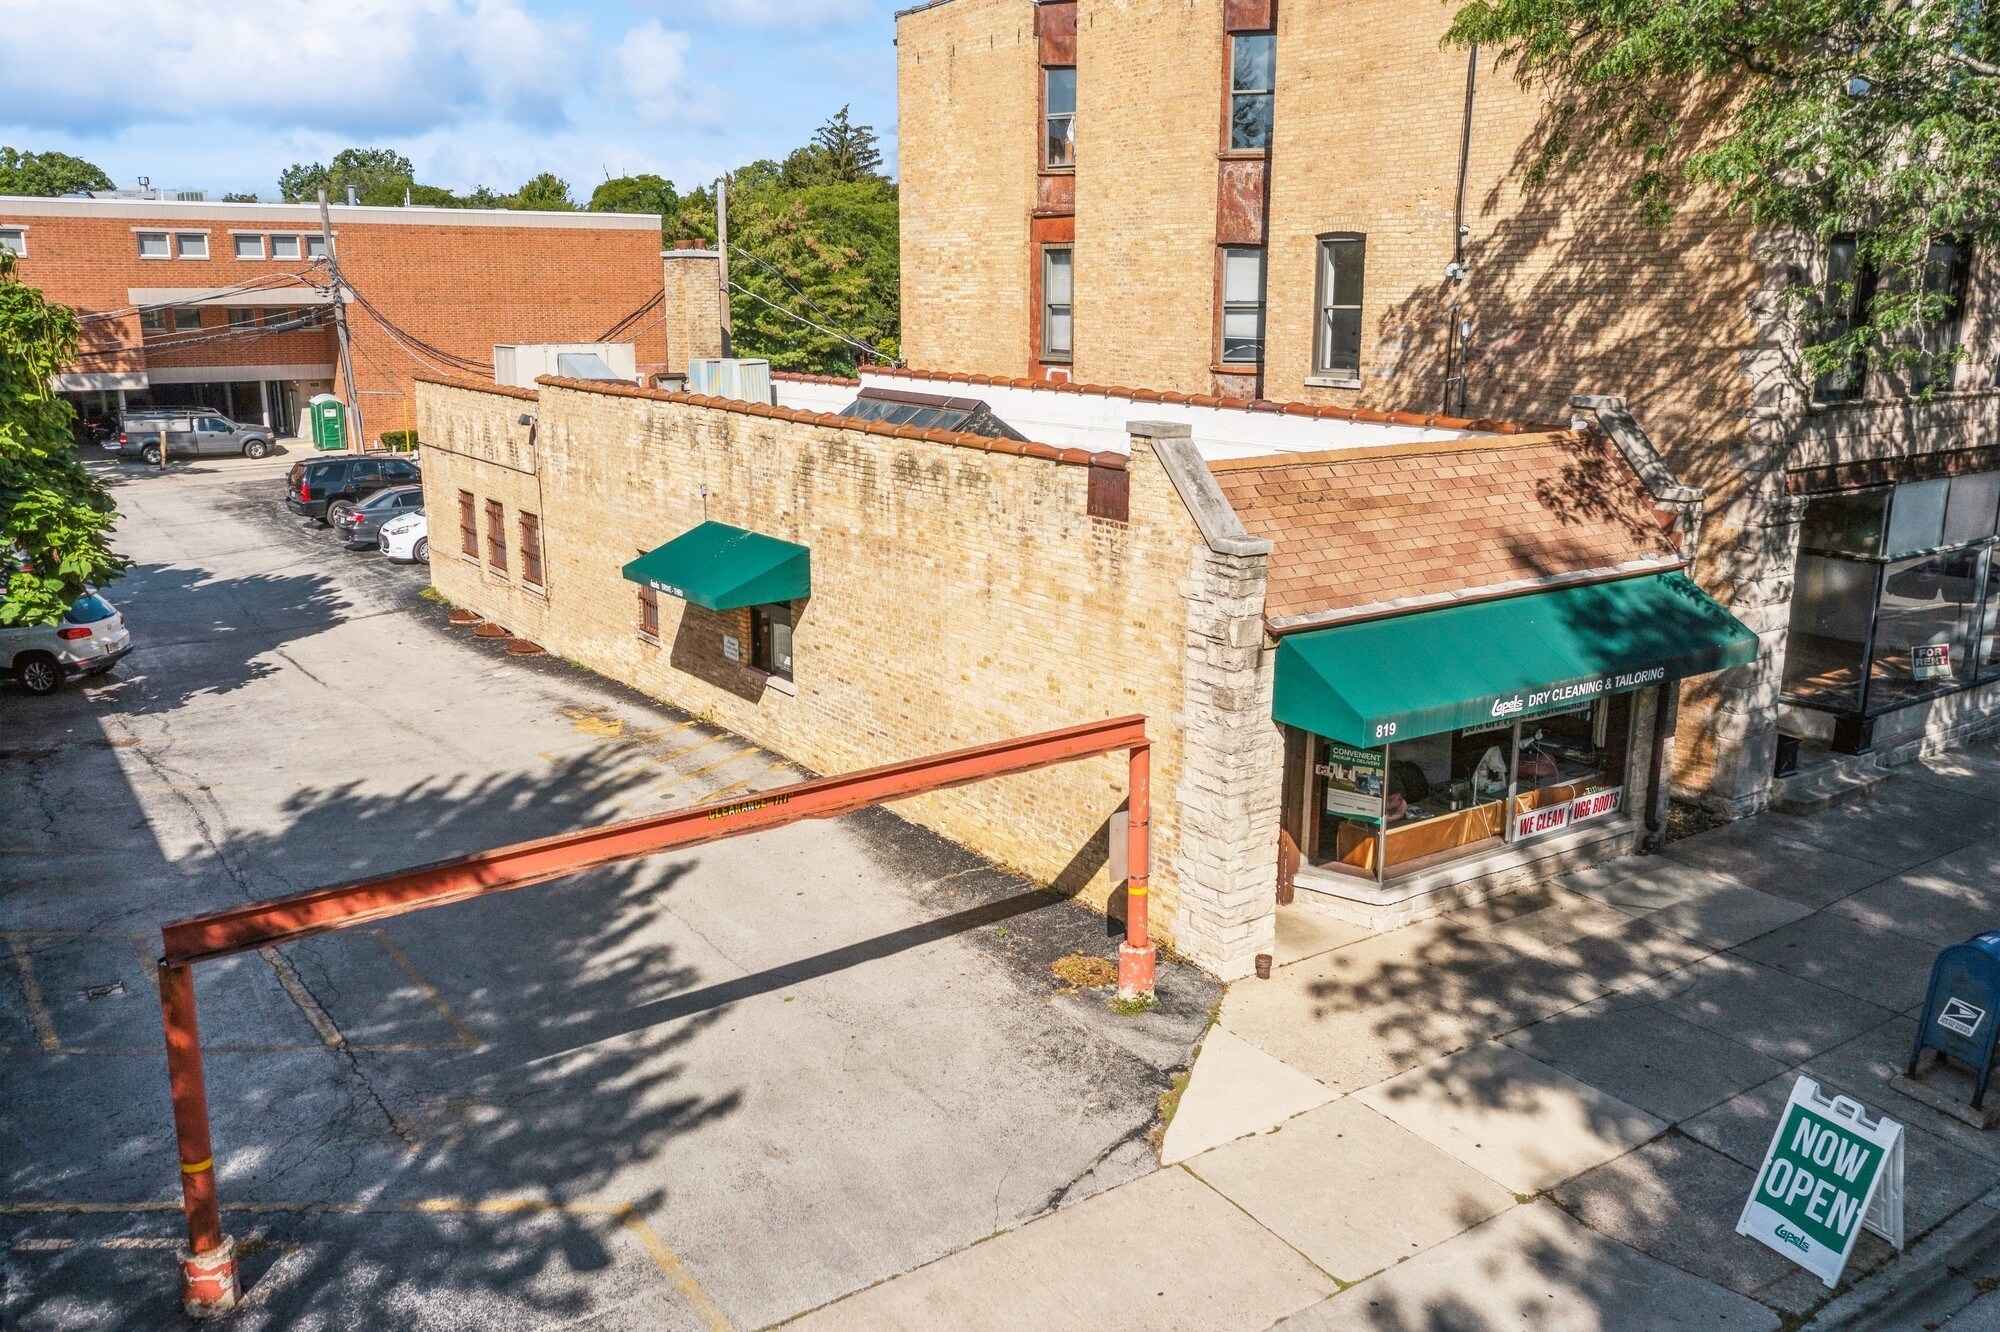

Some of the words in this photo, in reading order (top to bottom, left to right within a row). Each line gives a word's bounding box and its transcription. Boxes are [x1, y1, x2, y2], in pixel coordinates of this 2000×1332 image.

[1915, 655, 1947, 667] RENT
[1918, 647, 1942, 658] FOR
[1491, 694, 1524, 717] Lapels
[1528, 690, 1550, 708] DRY
[1551, 679, 1603, 702] CLEANING
[1605, 677, 1612, 690] &
[1614, 667, 1665, 688] TAILORING
[1375, 722, 1396, 738] 819
[1333, 747, 1382, 762] CONVENIENT
[1357, 758, 1381, 767] DELIVERY
[1573, 799, 1592, 820] UGG
[1592, 791, 1620, 814] BOOTS
[1520, 816, 1534, 836] WE
[1536, 807, 1565, 831] CLEAN
[1790, 1115, 1871, 1184] NOW
[1765, 1157, 1860, 1238] OPEN
[1774, 1223, 1810, 1253] Lapels
